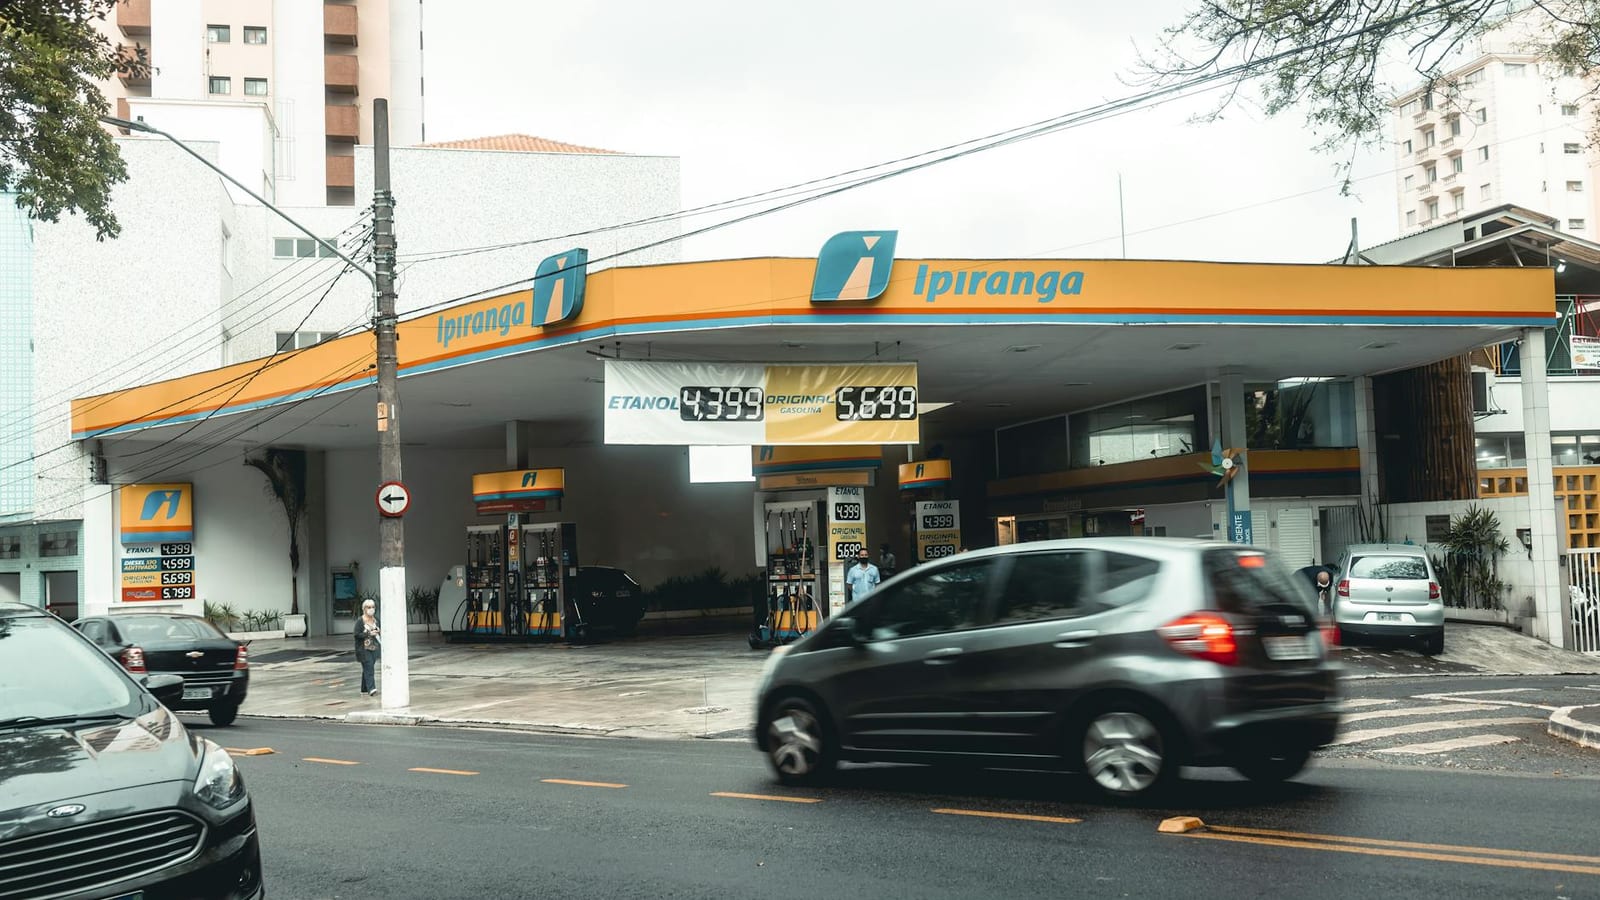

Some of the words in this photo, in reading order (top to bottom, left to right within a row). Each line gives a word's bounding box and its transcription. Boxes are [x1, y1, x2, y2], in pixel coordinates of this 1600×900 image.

[913, 264, 1085, 303] Ipiranga
[437, 301, 525, 348] Ipiranga
[607, 395, 679, 411] ETANOL
[766, 394, 835, 405] ORIGINAL
[780, 407, 822, 415] GASOLINA
[835, 487, 860, 496] ETANOL
[923, 502, 953, 510] ETANOL
[831, 527, 865, 535] ORIGINAL
[919, 533, 959, 541] ORIGINAL
